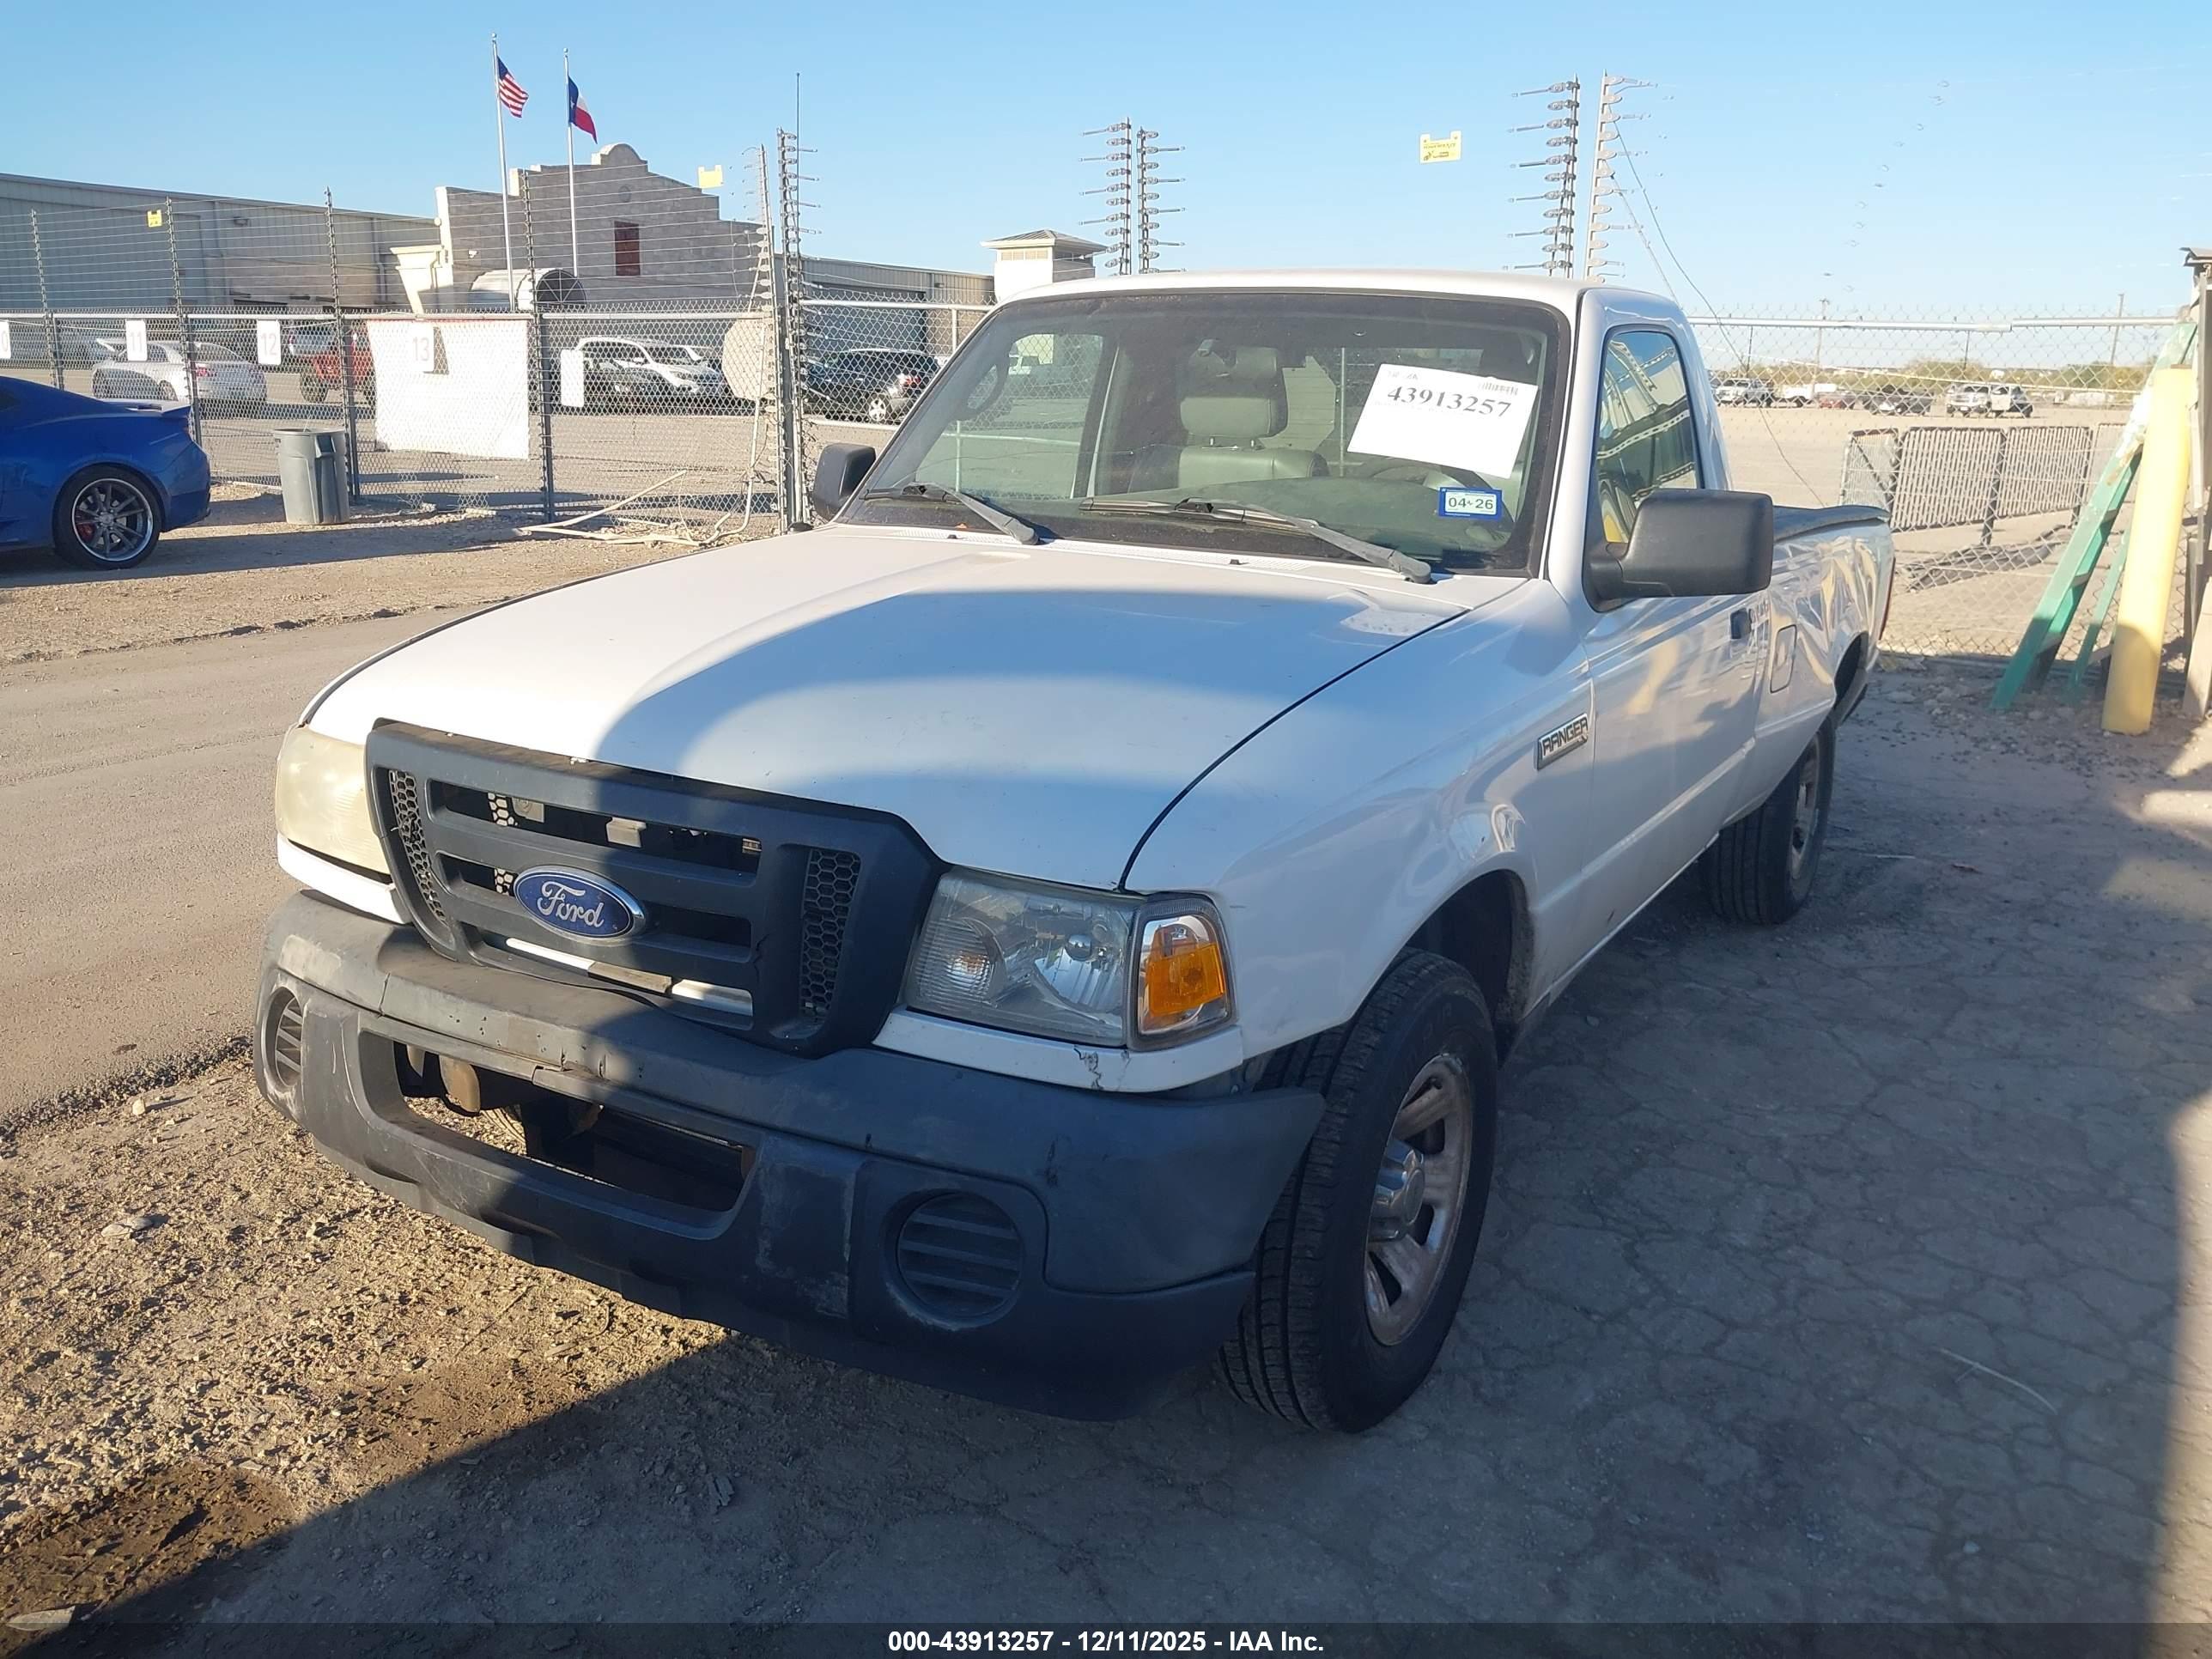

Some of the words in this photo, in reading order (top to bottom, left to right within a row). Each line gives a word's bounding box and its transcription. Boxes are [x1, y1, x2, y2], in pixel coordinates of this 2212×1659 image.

[130, 331, 143, 353] 11
[261, 332, 277, 356] 12
[412, 336, 431, 362] 13
[1387, 386, 1511, 418] 43913257
[1448, 497, 1467, 508] 04
[1474, 498, 1493, 510] 26
[1541, 716, 1589, 757] RANGER
[537, 880, 605, 928] Ford
